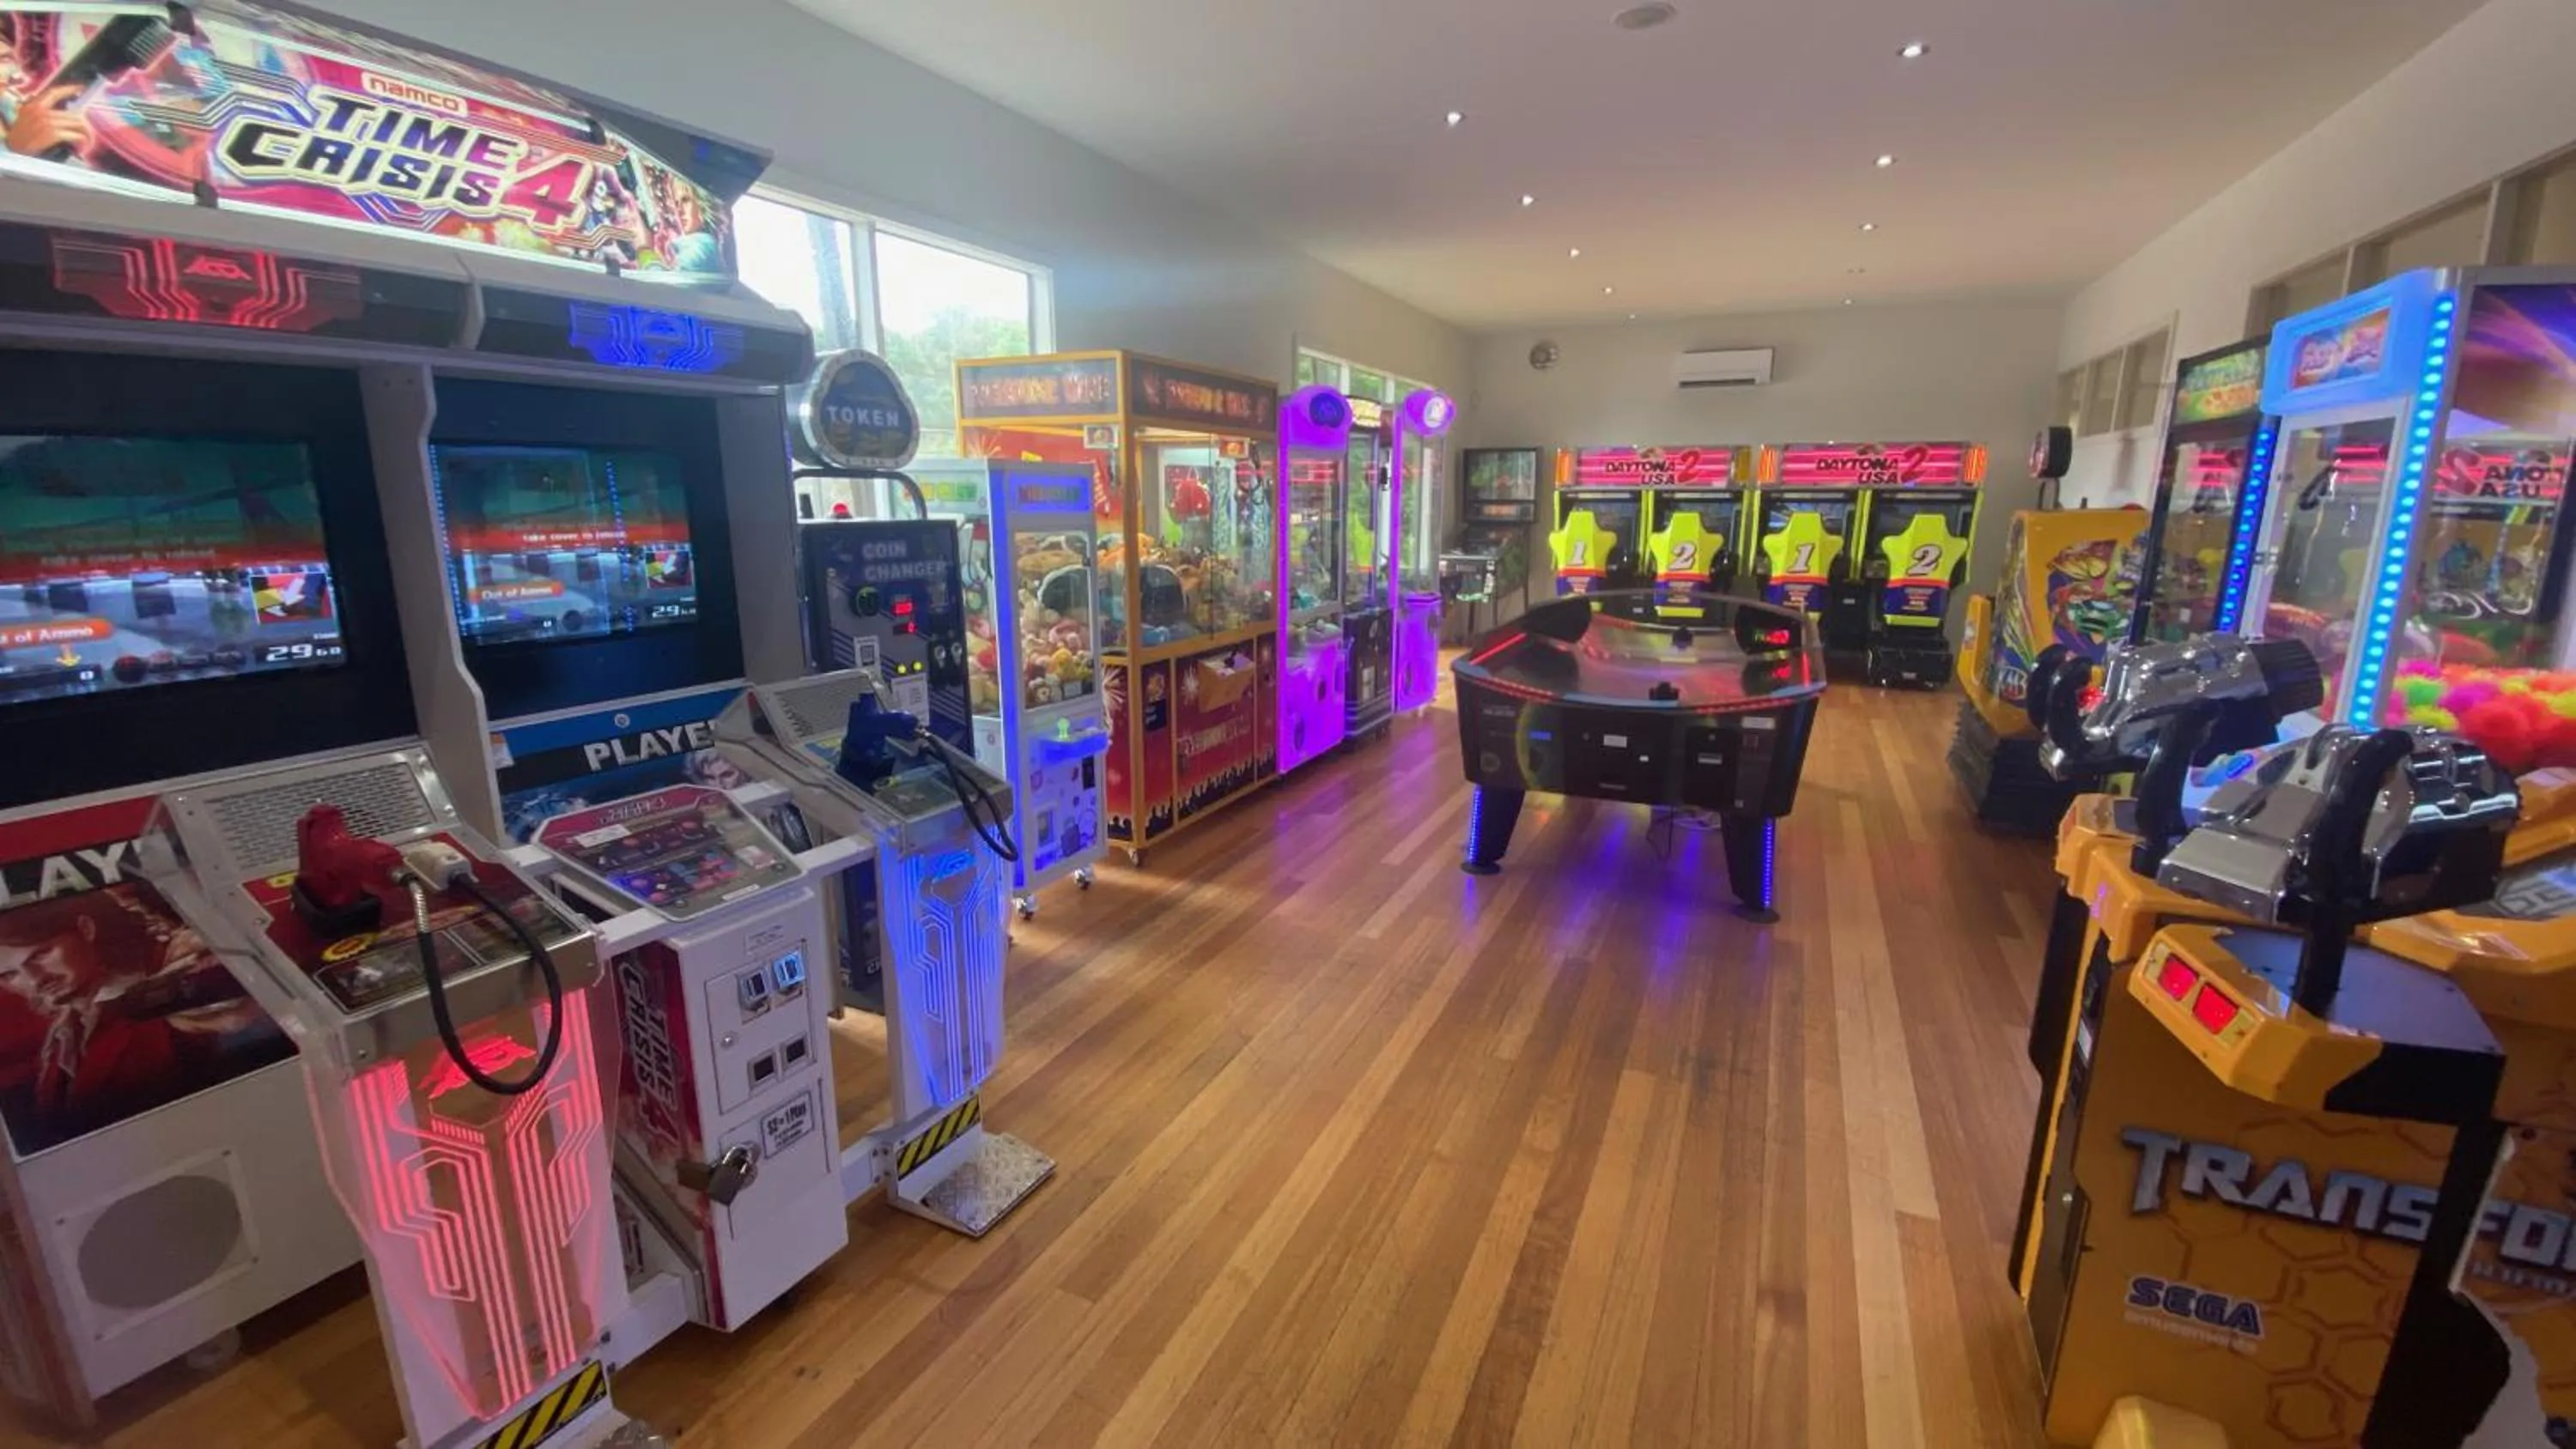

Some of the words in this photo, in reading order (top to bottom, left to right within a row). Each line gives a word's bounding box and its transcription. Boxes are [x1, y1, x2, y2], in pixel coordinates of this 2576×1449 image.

[369, 76, 461, 112] namco
[321, 94, 519, 169] TIME
[225, 122, 501, 208] CRISIS
[500, 158, 585, 227] 4
[827, 406, 900, 427] TOKEN
[1605, 460, 1675, 473] DAYTONA
[1675, 449, 1702, 483] 2
[1641, 473, 1676, 485] USA
[1815, 458, 1899, 471] DAYTONA
[1899, 446, 1929, 482] 2
[1857, 472, 1899, 484] USA
[861, 541, 907, 558] COIN
[1571, 541, 1586, 567] 1
[1669, 540, 1697, 571] 2
[1786, 543, 1814, 573] 1
[1906, 543, 1942, 577] 2
[864, 561, 948, 581] CHANGER
[652, 604, 679, 618] 29
[15, 627, 31, 643] of
[39, 625, 94, 641] Ammo
[266, 643, 313, 662] 29
[583, 719, 718, 772] PLAYE
[0, 838, 143, 912] LAY
[2477, 1199, 2576, 1272] FO
[2126, 1275, 2263, 1337] SEGA
